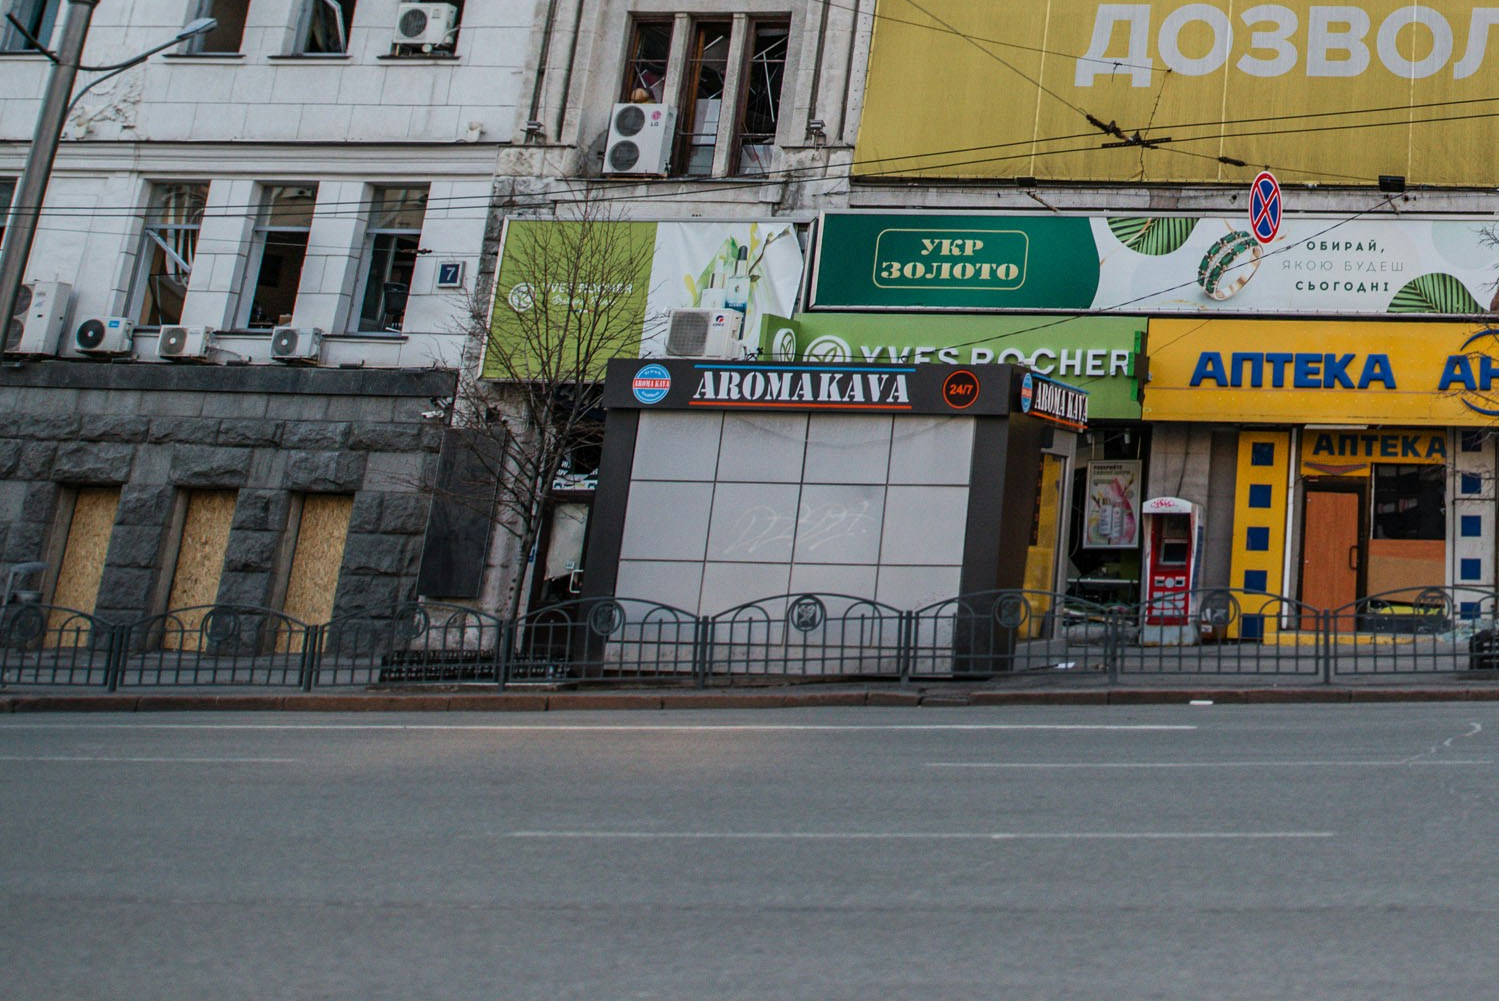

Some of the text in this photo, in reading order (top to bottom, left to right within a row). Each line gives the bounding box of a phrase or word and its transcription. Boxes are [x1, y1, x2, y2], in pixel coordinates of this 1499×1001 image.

[920, 238, 984, 257] УКР
[1306, 239, 1385, 254] ОБИРАЙ,
[446, 266, 456, 281] 7
[880, 261, 1019, 281] ЗОЛОТО
[1281, 259, 1405, 273] ЯКОЮ БУДЕШ
[1295, 280, 1390, 294] СЬОГОДНІ
[1188, 351, 1397, 390] АПТЕКА
[949, 384, 974, 396] 24/7
[1034, 381, 1066, 416] AROMA
[1312, 432, 1447, 458] АПТЕКА
